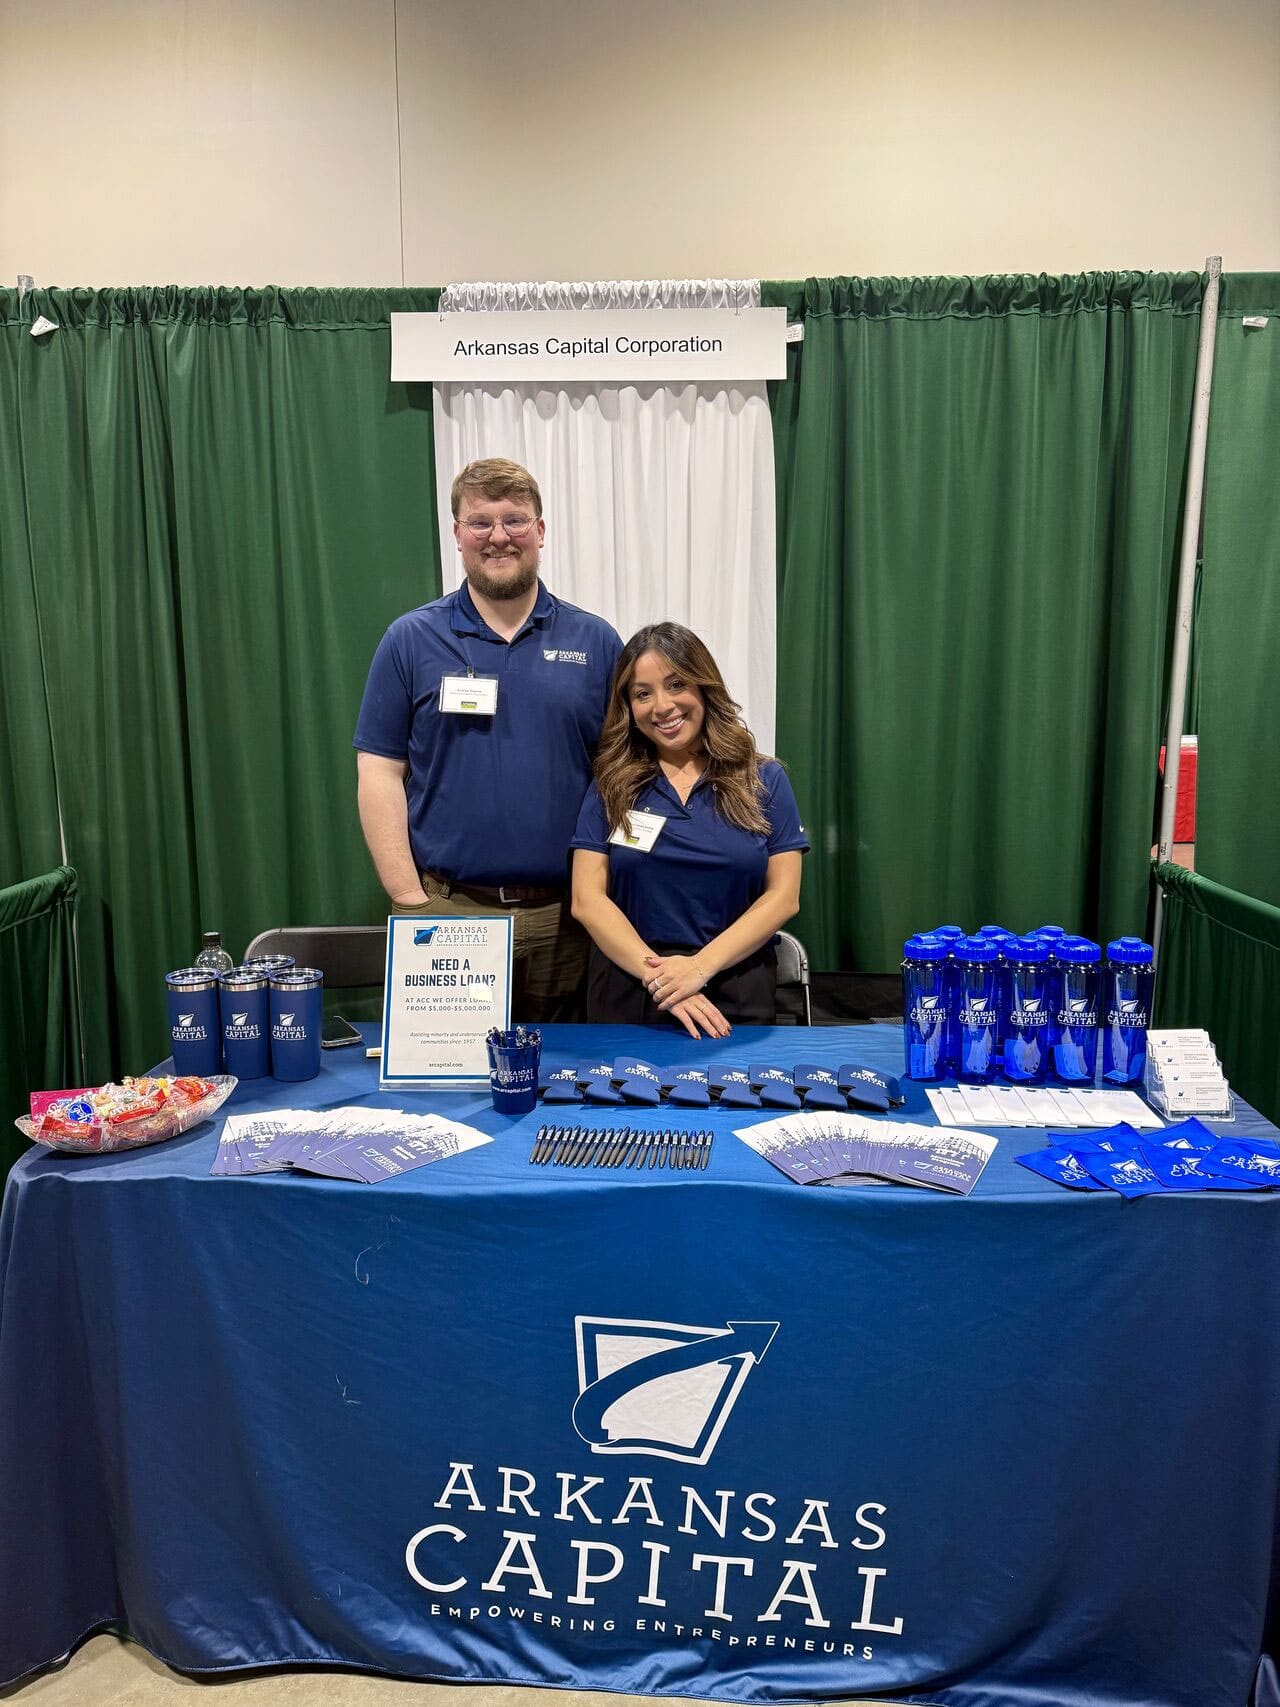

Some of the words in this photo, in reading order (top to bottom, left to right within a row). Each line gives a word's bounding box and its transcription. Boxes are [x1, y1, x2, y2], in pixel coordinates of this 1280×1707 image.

[453, 338, 540, 356] Arkansas
[545, 337, 609, 358] Capital
[615, 336, 723, 357] Corporation
[437, 926, 488, 934] ARKANSAS
[436, 934, 488, 943] CAPITAL
[431, 958, 459, 971] NEED
[463, 958, 471, 971] A
[405, 974, 457, 987] BUSINESS
[910, 1013, 947, 1021] CAPITAL
[958, 1015, 997, 1023] CAPITAL
[1010, 1015, 1048, 1024] CAPITAL
[1057, 1015, 1097, 1024] CAPITAL
[1107, 1015, 1147, 1025] CAPITAL
[171, 1031, 208, 1039] CAPITAL
[225, 1029, 261, 1038] CAPITAL
[272, 1030, 307, 1039] CAPITAL
[498, 1073, 534, 1082] CAPITAL
[434, 1462, 887, 1551] ARKANSAS
[405, 1524, 904, 1636] CAPITAL
[431, 1603, 616, 1632] EMPOWERING
[636, 1619, 874, 1660] ENTREPRENEURS
